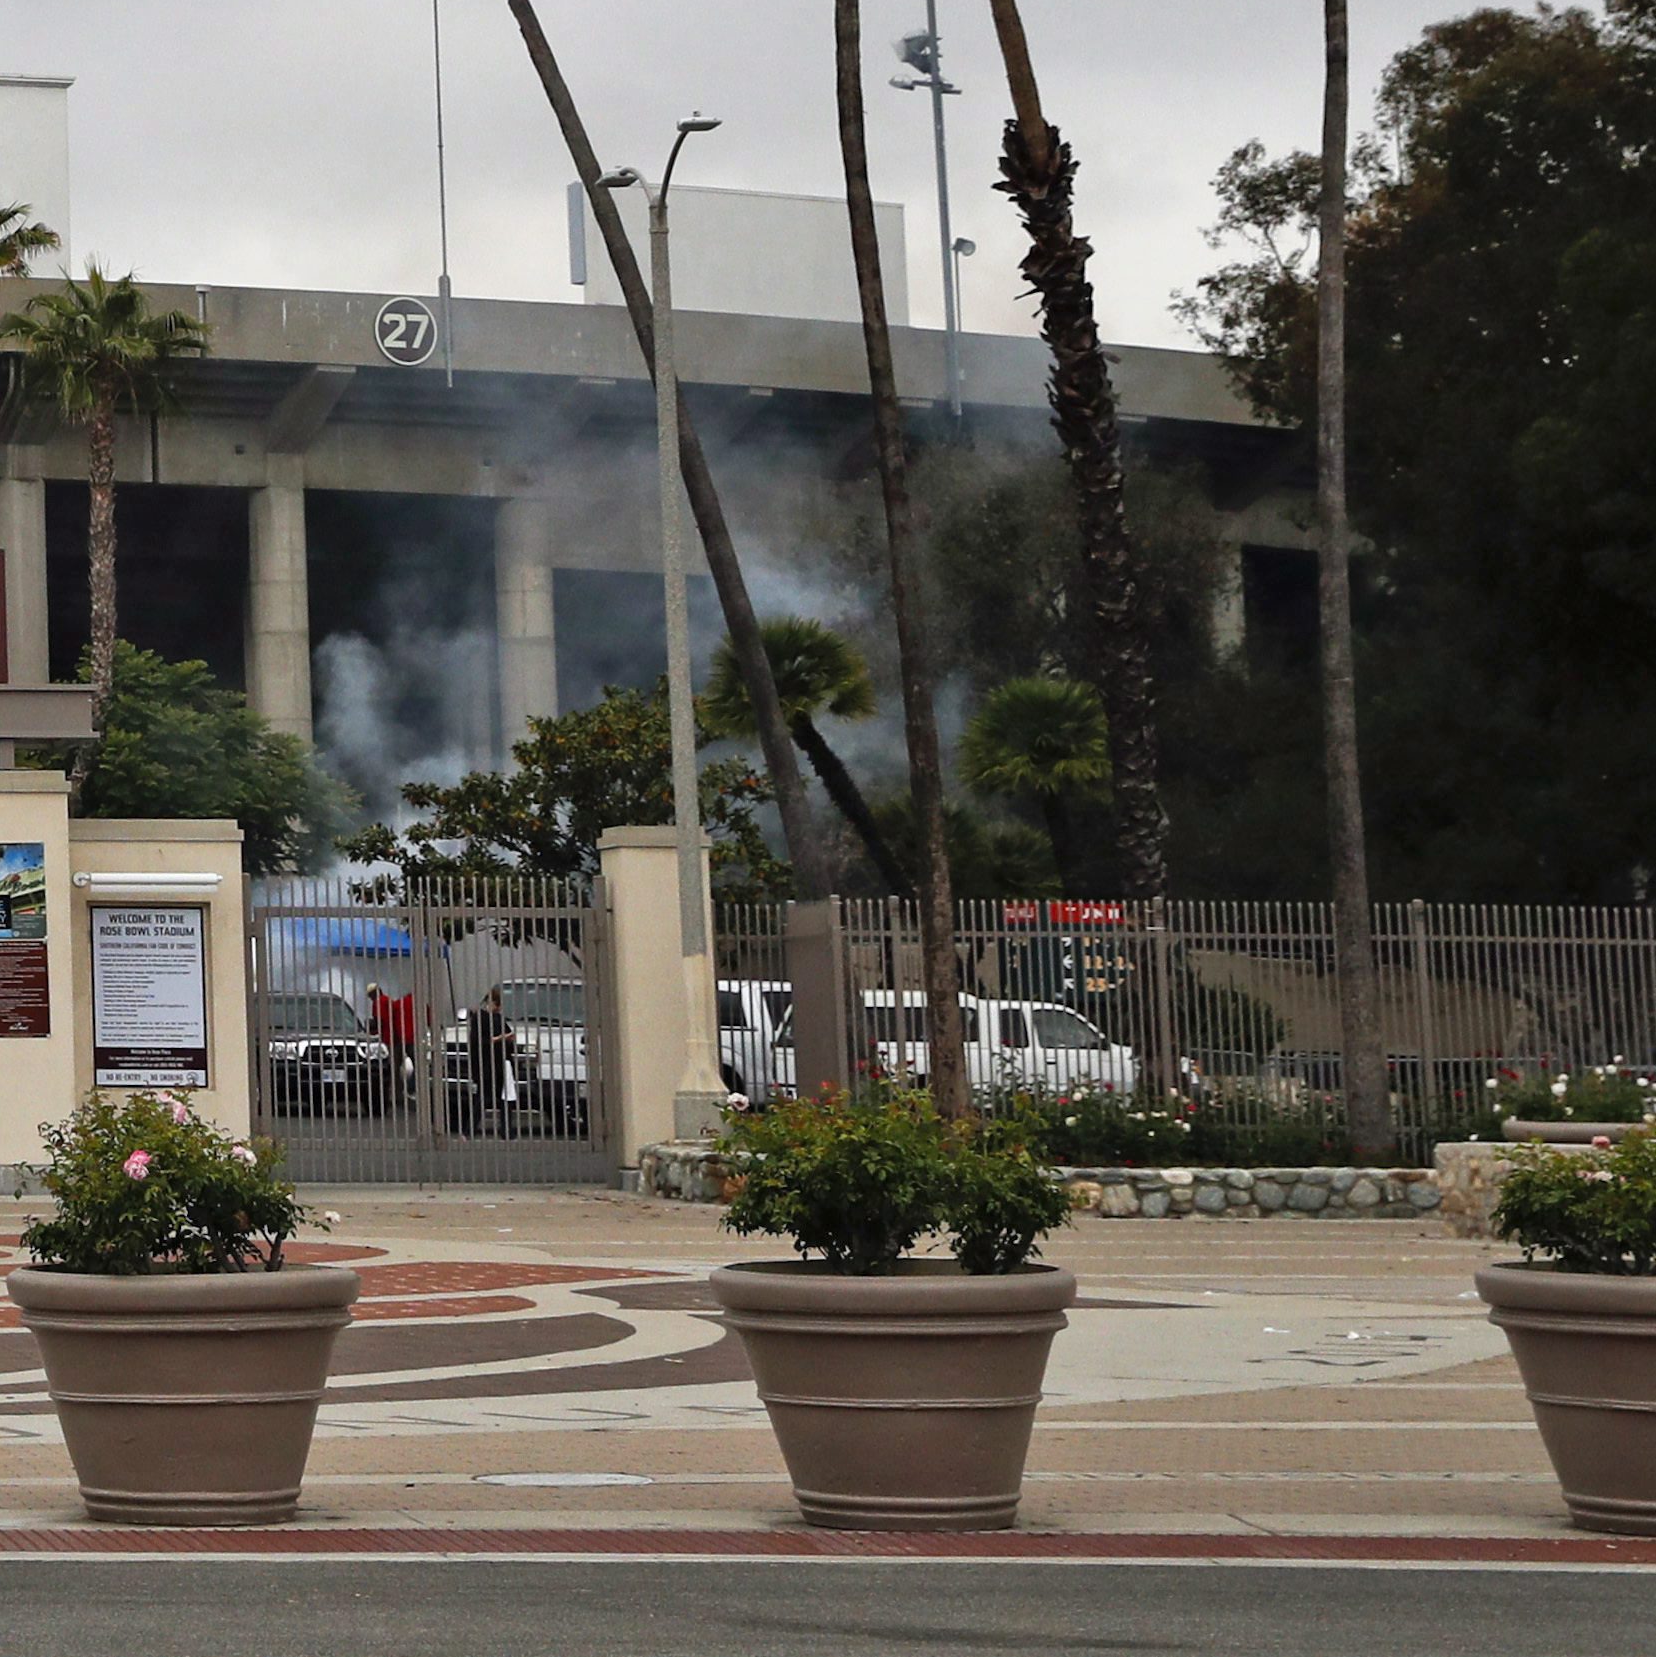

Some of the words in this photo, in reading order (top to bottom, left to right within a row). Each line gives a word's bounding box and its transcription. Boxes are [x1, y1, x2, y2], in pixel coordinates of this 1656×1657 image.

[382, 313, 429, 349] 27
[109, 914, 152, 924] WELCOME
[155, 914, 166, 924] TO
[169, 914, 185, 924] THE
[99, 926, 122, 937] ROSE
[125, 926, 151, 937] BOWL
[154, 926, 195, 937] STADIUM
